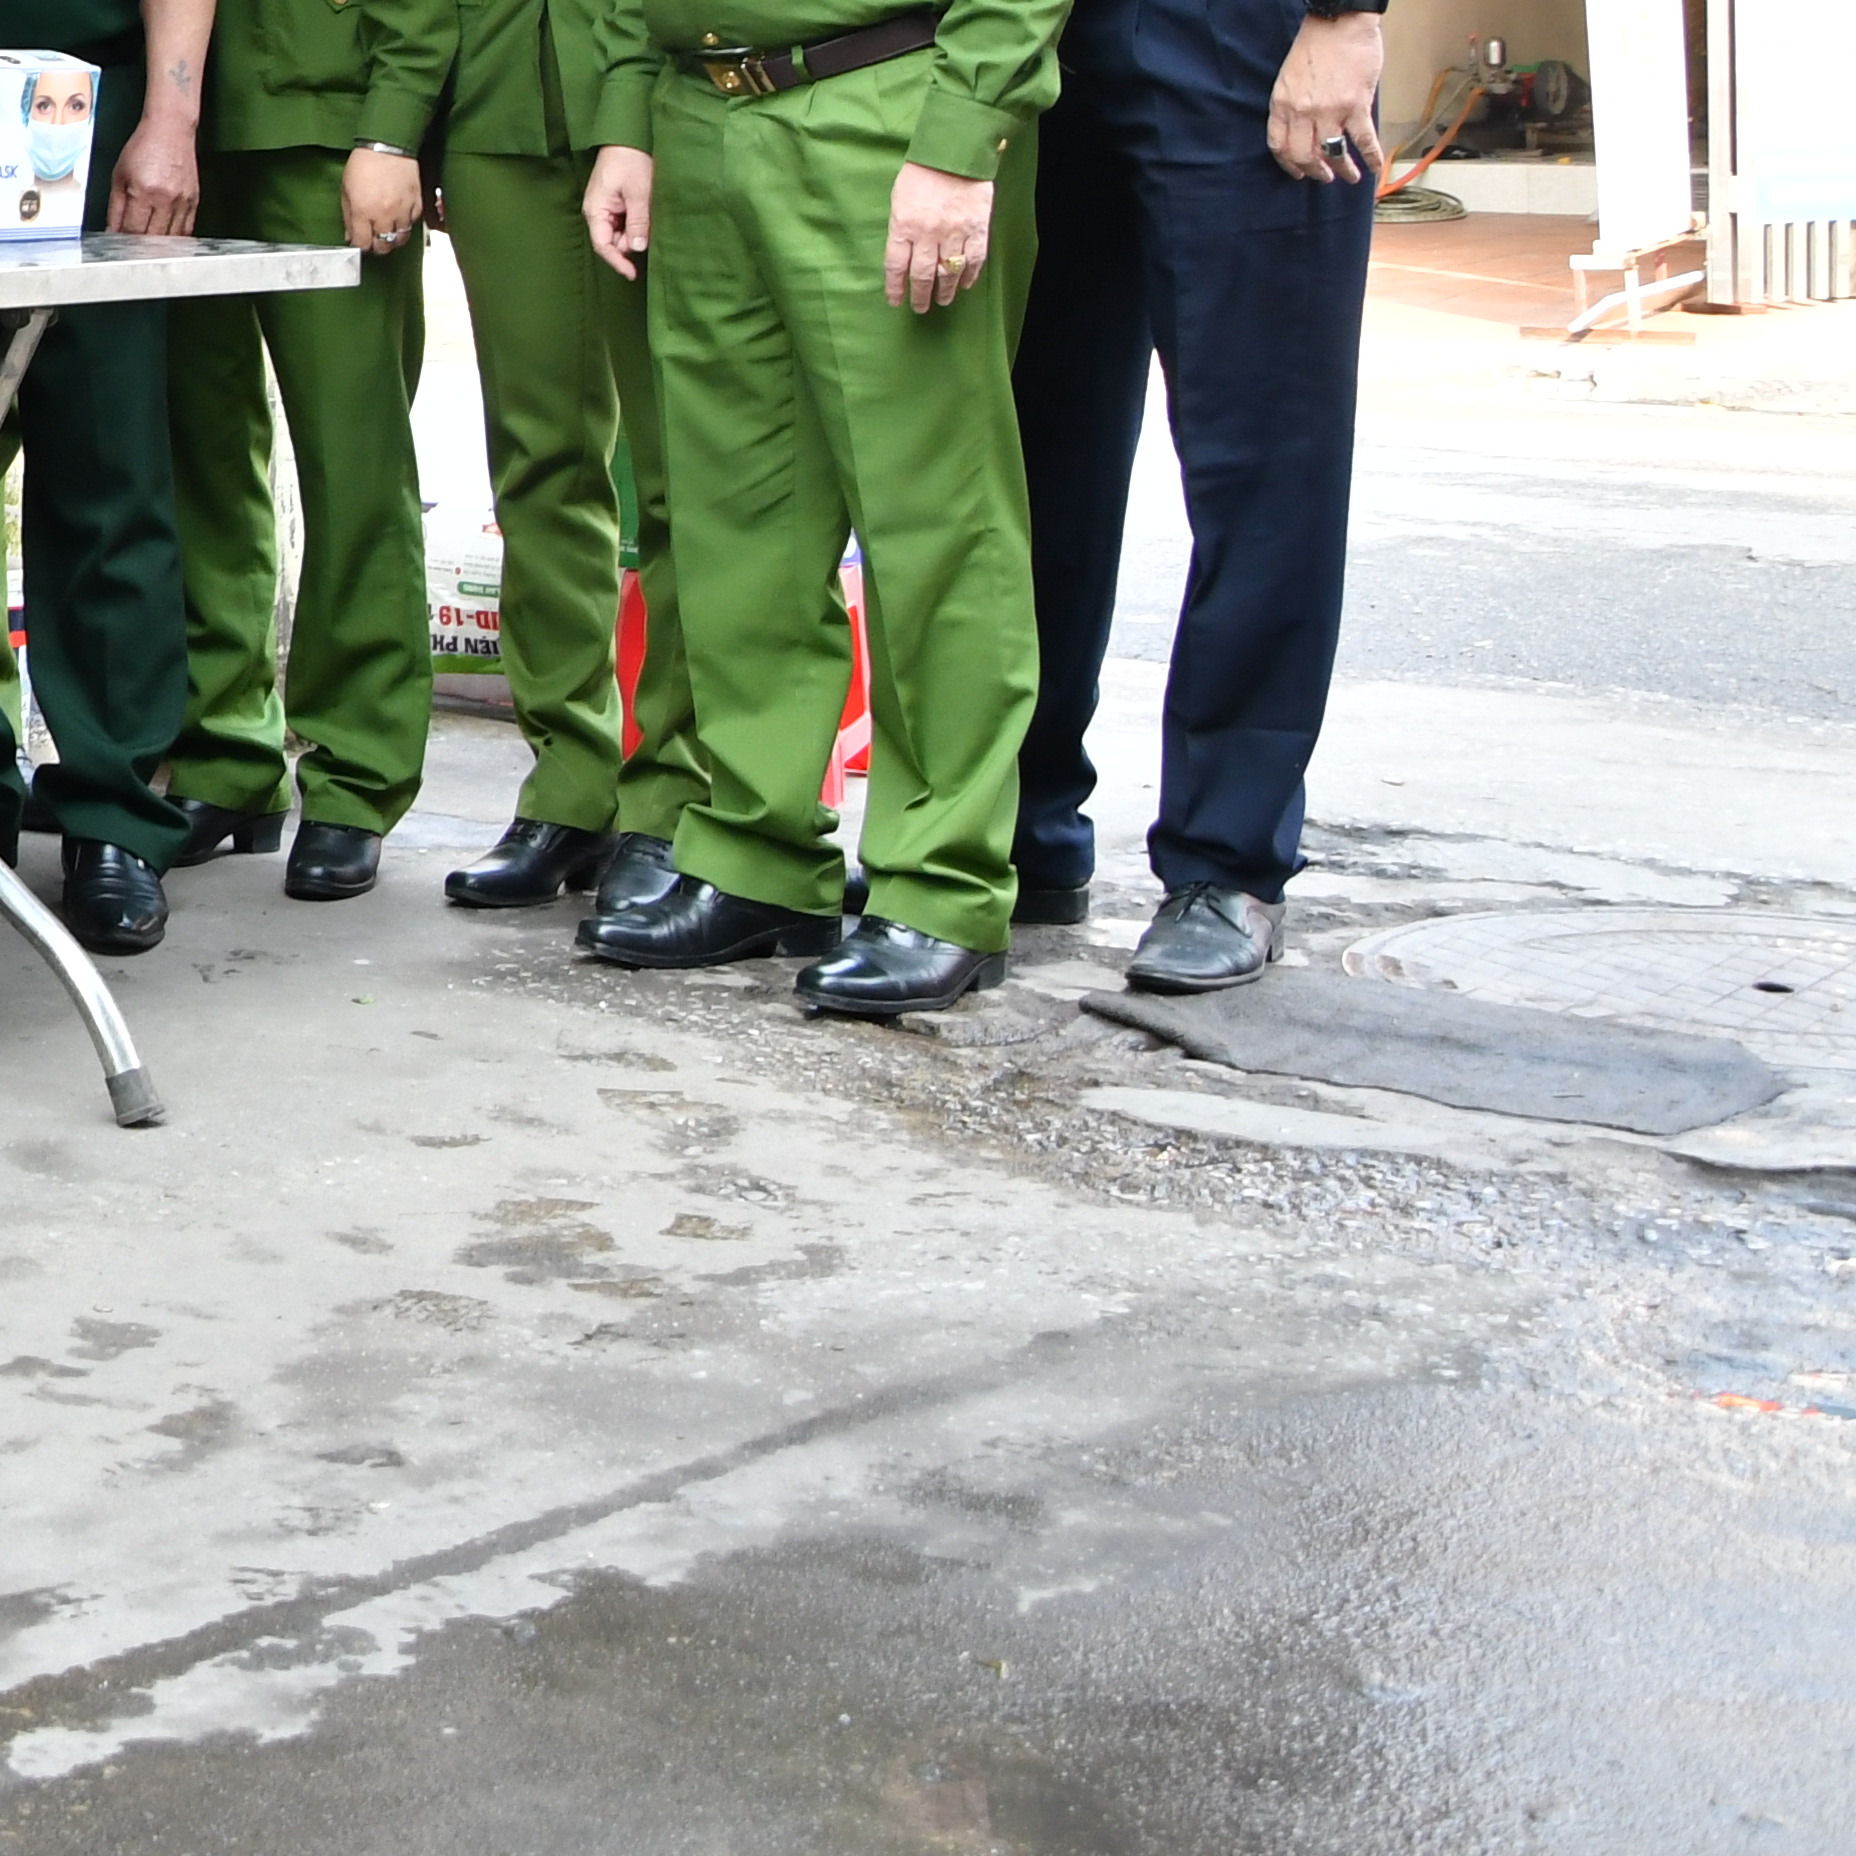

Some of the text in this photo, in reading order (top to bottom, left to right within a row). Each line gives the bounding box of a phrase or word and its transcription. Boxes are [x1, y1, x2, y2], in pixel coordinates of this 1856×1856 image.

[439, 605, 500, 632] ID-19
[431, 633, 500, 656] IỆN PH
